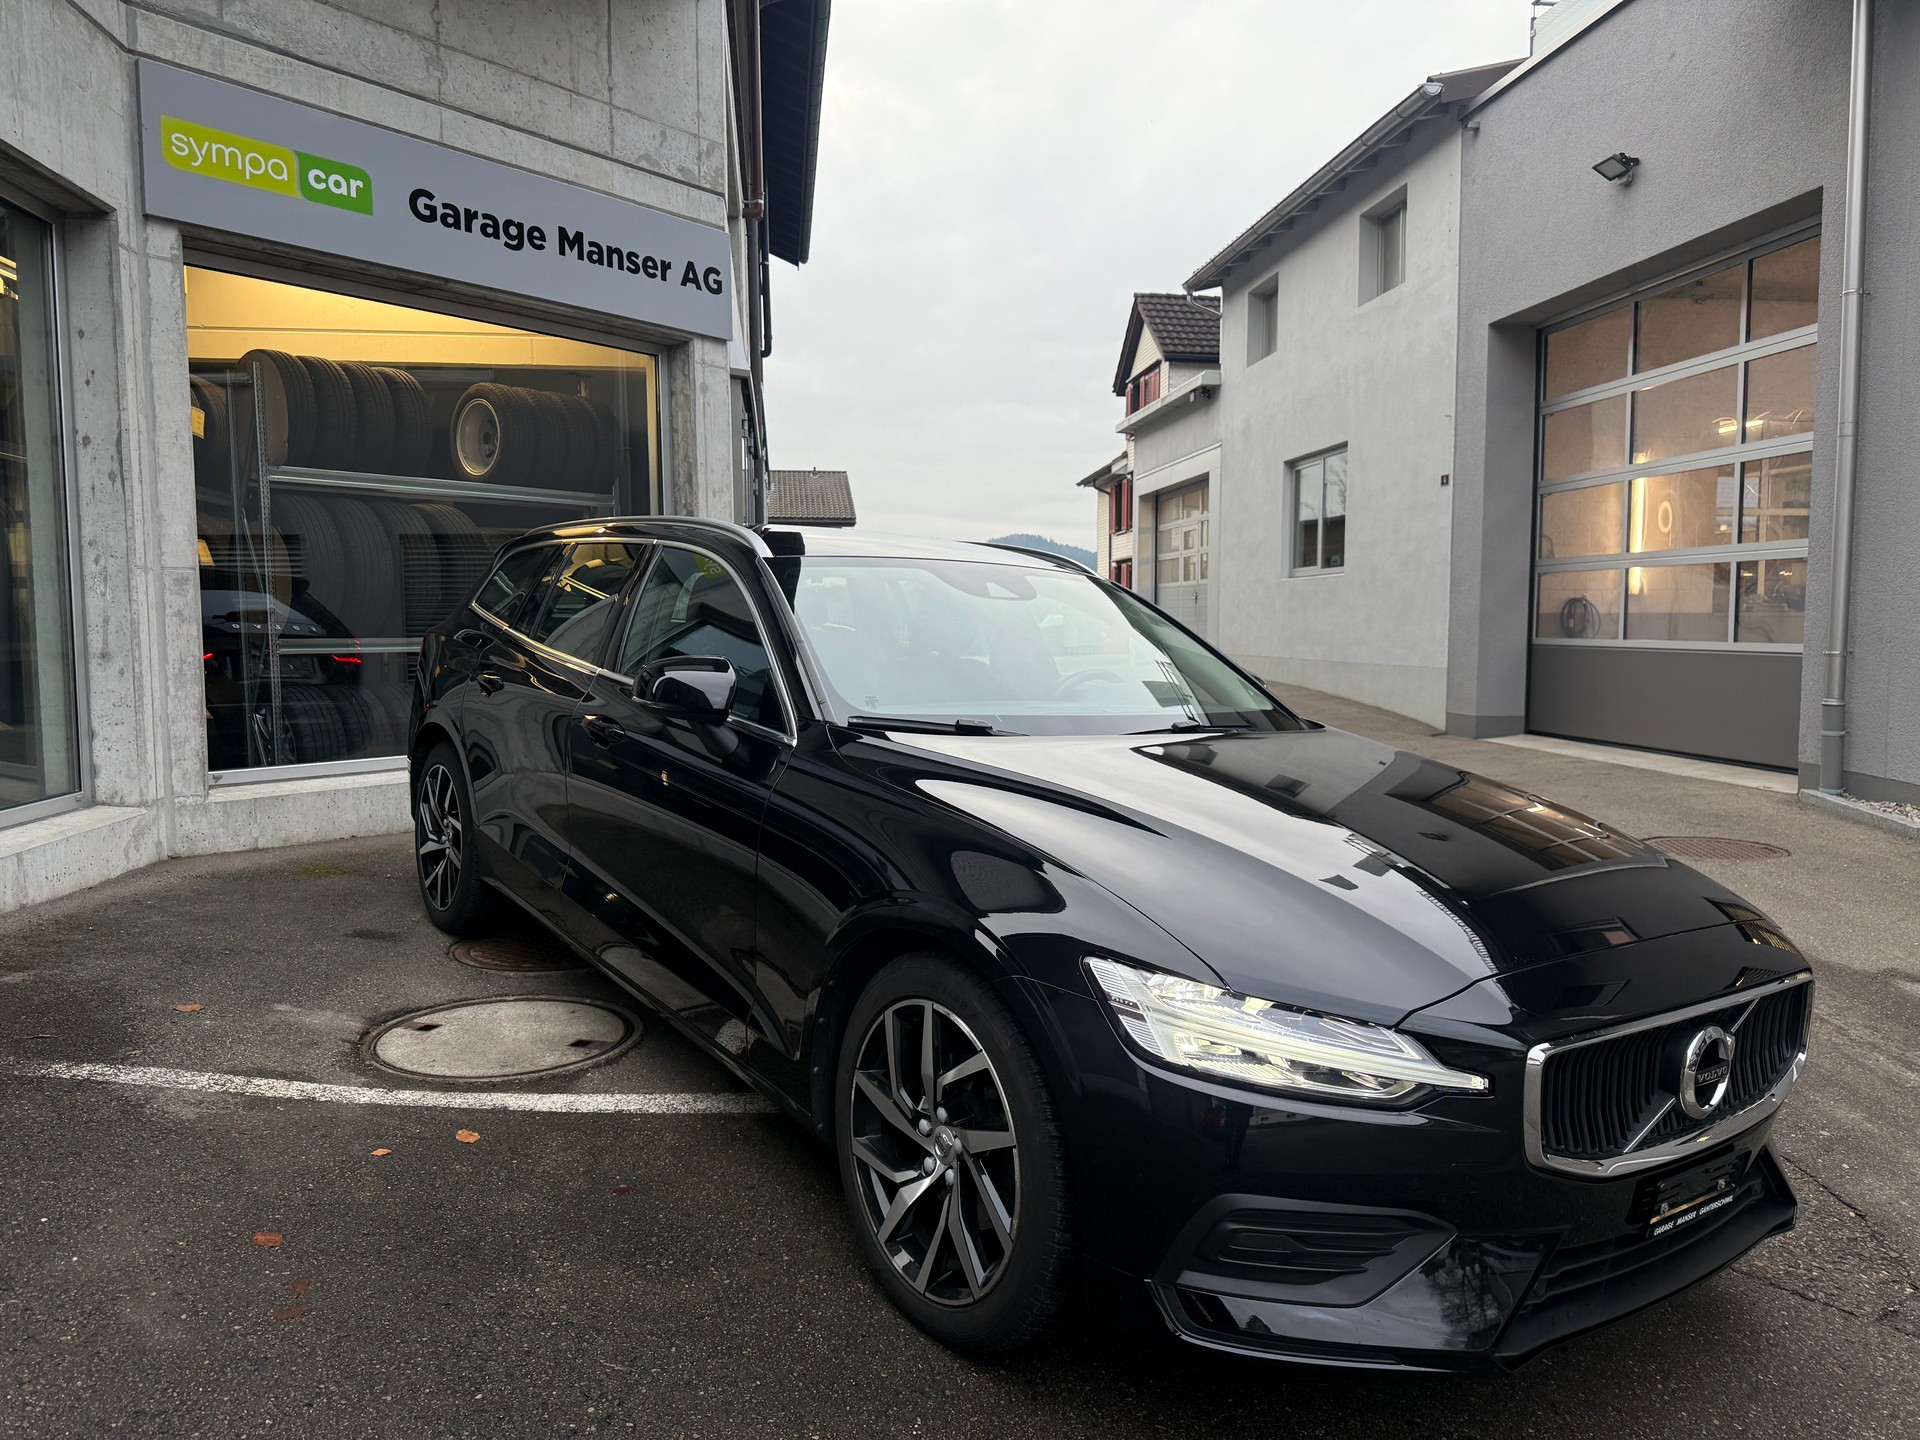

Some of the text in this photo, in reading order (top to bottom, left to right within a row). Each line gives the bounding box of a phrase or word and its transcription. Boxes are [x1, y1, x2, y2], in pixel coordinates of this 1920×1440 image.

[171, 132, 364, 198] sympa car
[408, 188, 723, 295] Garage Manser AG
[1697, 1066, 1727, 1083] VOLVO
[1654, 1221, 1675, 1236] GARAGE
[1676, 1211, 1697, 1226] MANSER
